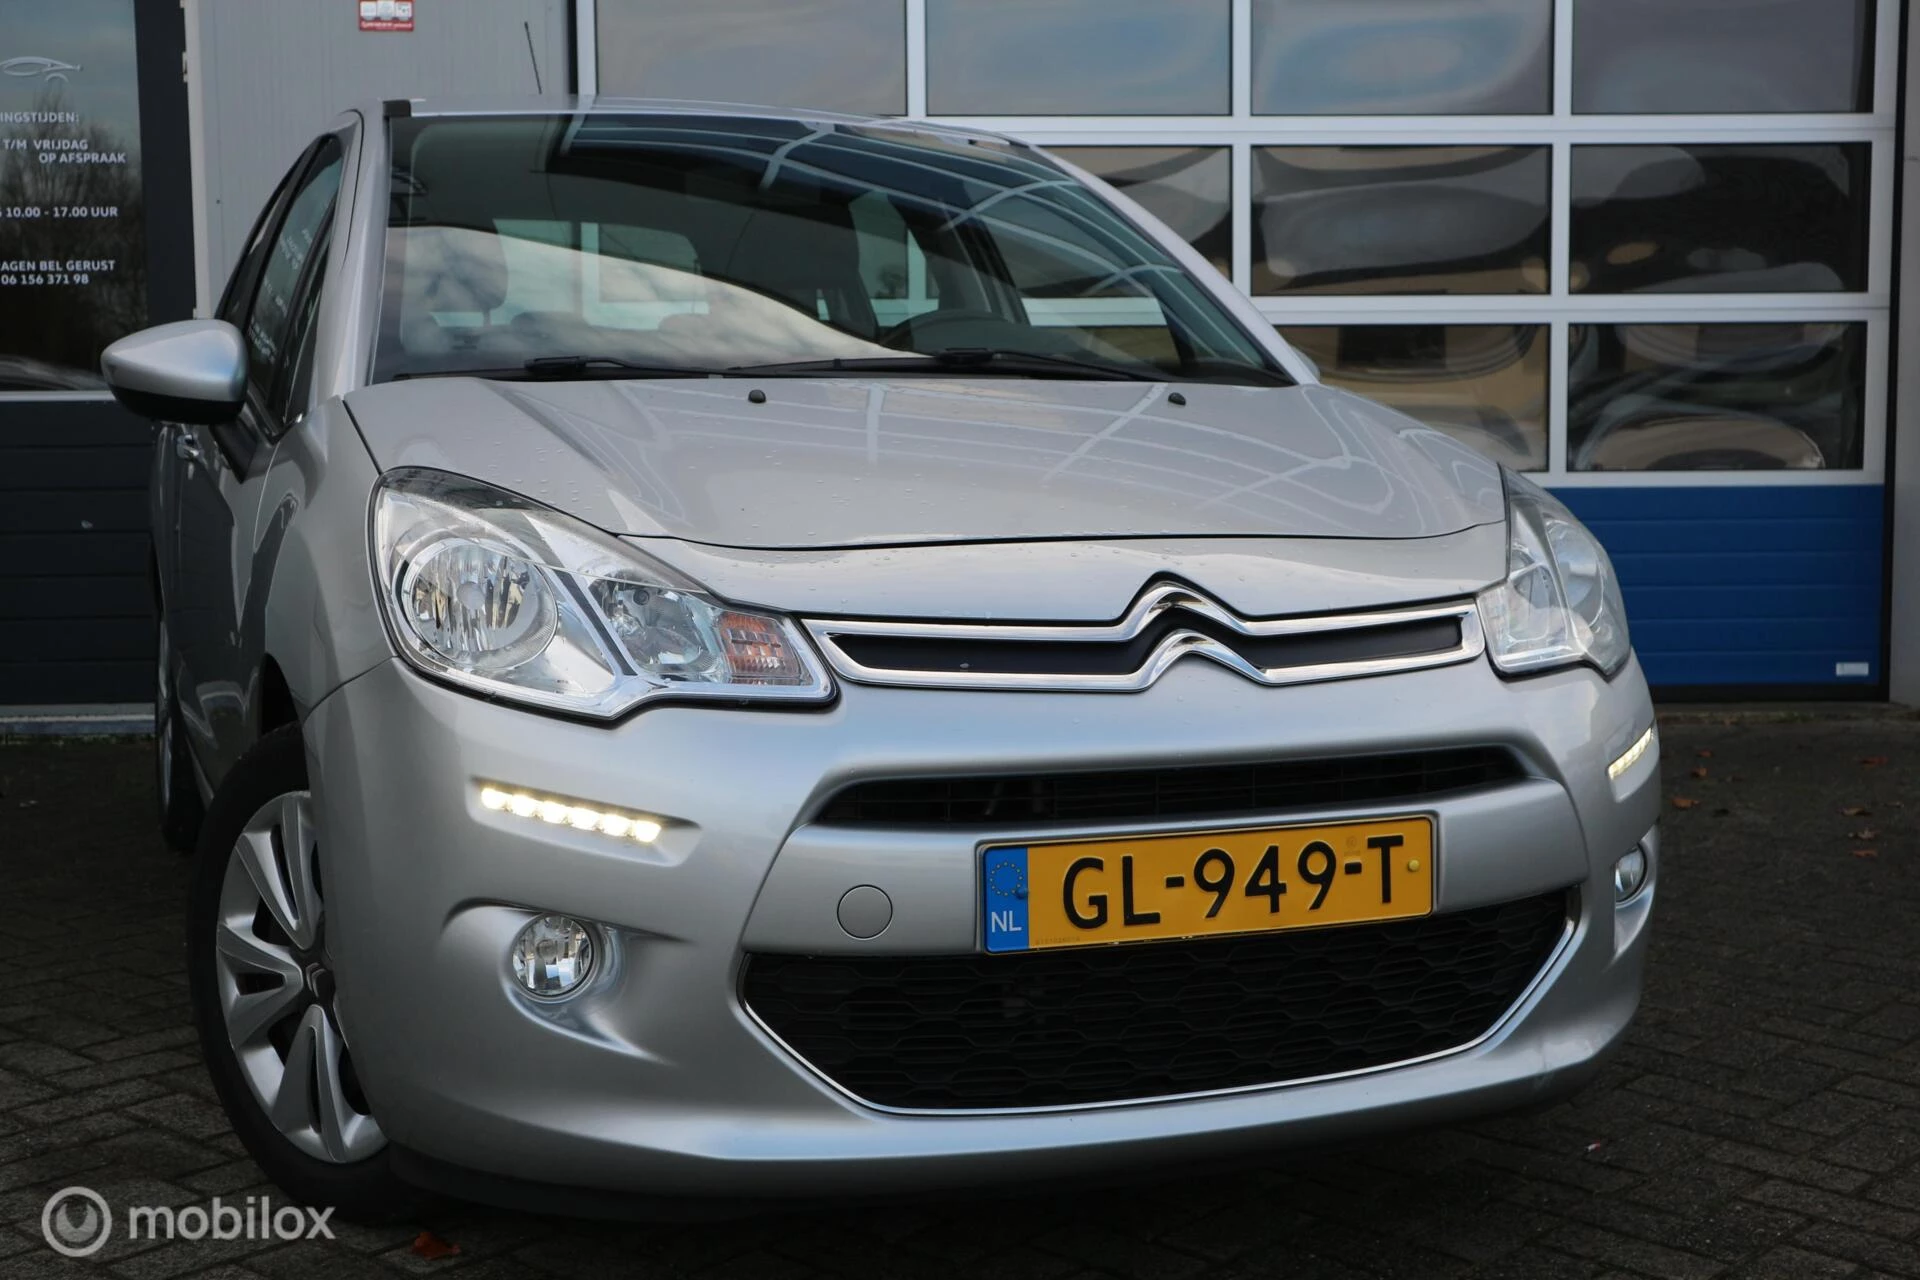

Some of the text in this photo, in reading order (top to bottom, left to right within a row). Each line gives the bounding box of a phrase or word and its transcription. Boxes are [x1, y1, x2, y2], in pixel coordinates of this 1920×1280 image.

[3, 139, 89, 150] T/M VRIJDAG
[39, 152, 126, 163] OP AFSPRAAK
[6, 206, 41, 218] 10.00
[53, 206, 88, 218] 17.00
[90, 206, 118, 217] UUR
[39, 261, 63, 271] BEL
[66, 260, 116, 271] GERUST
[1, 273, 89, 285] 06 156 371 98
[1062, 834, 1404, 930] GL-949-T
[990, 911, 1023, 934] NL
